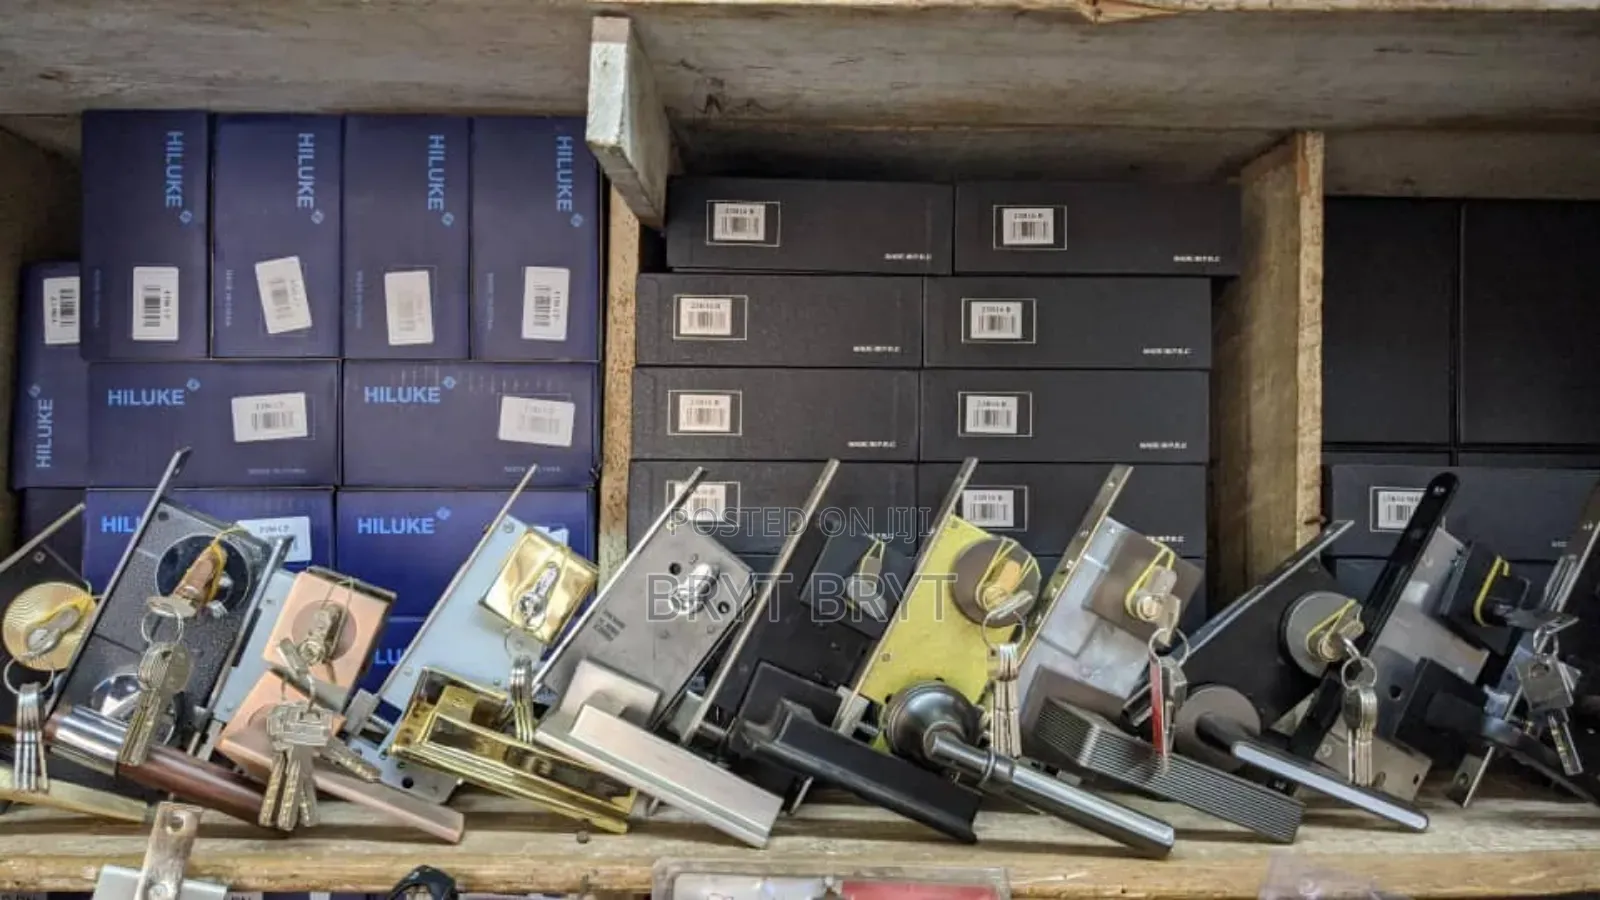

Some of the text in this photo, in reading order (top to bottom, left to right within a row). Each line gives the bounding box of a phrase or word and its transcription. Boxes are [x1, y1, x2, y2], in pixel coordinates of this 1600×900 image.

[165, 131, 184, 208] HILUKE
[296, 133, 315, 209] HILUKE
[427, 135, 446, 211] HILUKE
[556, 136, 574, 212] HILUKE
[107, 389, 186, 406] HILUKE
[364, 386, 441, 404] HILUKE
[36, 399, 54, 468] HILUKE
[357, 517, 436, 534] HILUKE
